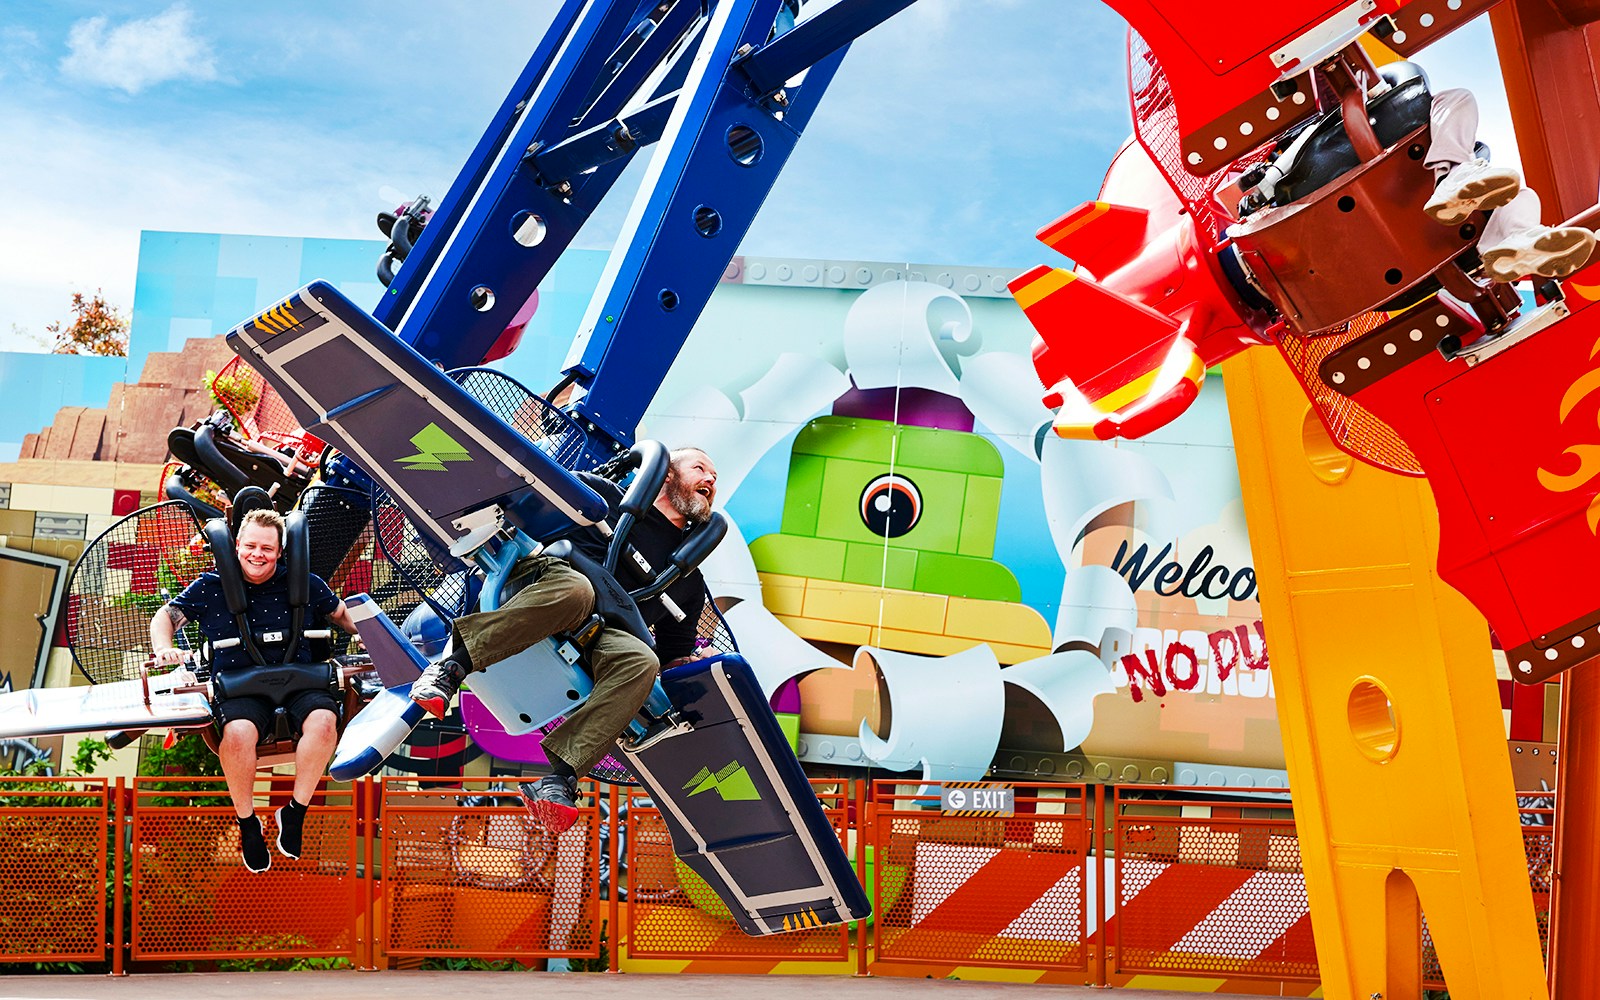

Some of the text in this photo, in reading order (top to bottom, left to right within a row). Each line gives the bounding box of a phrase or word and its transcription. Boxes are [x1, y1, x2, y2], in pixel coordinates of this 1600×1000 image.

[1111, 540, 1260, 603] Welco
[1121, 641, 1199, 703] NO
[973, 791, 1006, 809] EXIT
